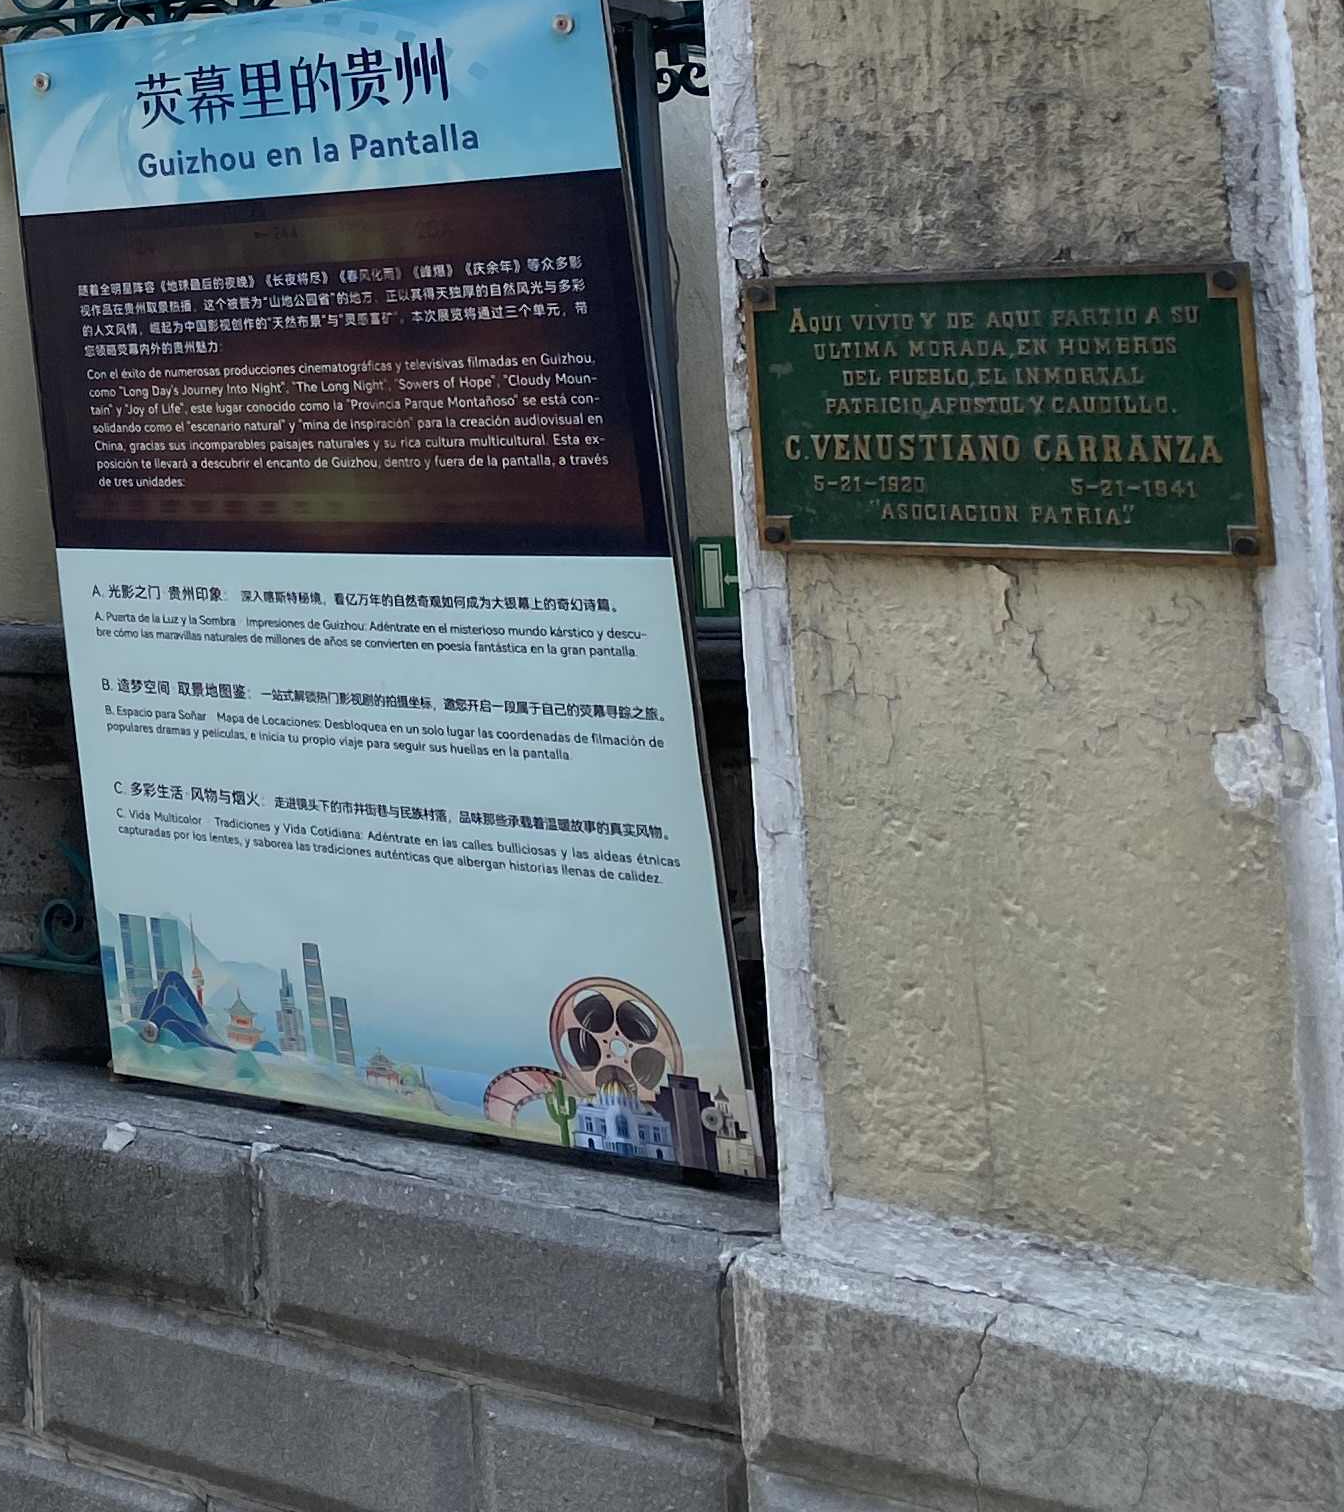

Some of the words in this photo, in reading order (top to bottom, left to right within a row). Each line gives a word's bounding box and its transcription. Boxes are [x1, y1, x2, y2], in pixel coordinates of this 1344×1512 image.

[134, 37, 449, 130] 荧幕里的贵州
[137, 147, 256, 178] Guizhou
[266, 146, 303, 168] en
[312, 136, 340, 164] la
[349, 122, 479, 161] Pantalla
[789, 307, 842, 335] AQUI
[851, 313, 914, 332] VIVIO
[919, 311, 937, 330] Y
[946, 311, 975, 330] DE
[986, 309, 1042, 330] AQUI
[1052, 308, 1137, 328] PARTIO
[1145, 306, 1161, 325] A
[1171, 306, 1199, 325] SU
[814, 340, 897, 361] ULTIMA
[1016, 338, 1047, 356] EN
[1059, 336, 1178, 355] HOMBROS
[86, 368, 107, 380] Con
[109, 368, 119, 380] el
[120, 368, 146, 379] éxito
[148, 367, 162, 379] de
[164, 367, 221, 378] numerosas
[223, 364, 296, 379] producciones
[298, 359, 393, 376] cinematográficas
[404, 358, 465, 371] televisivas
[466, 354, 519, 368] filmadas
[521, 356, 538, 366] en
[842, 369, 881, 387] DEL
[976, 367, 1008, 386] EL
[1015, 366, 1146, 386] INMORTAL
[88, 388, 117, 398] como
[181, 384, 224, 398] Journey
[226, 383, 248, 395] Into
[320, 381, 350, 395] Long
[442, 376, 456, 389] of
[554, 372, 598, 385] Moun-
[147, 402, 159, 415] of
[190, 403, 213, 414] este
[215, 402, 243, 416] lugar
[246, 400, 296, 413] conocido
[298, 401, 330, 412] como
[332, 400, 344, 411] la
[404, 397, 444, 411] Parque
[522, 396, 537, 407] se
[540, 393, 568, 406] está
[570, 395, 600, 405] con-
[930, 396, 1025, 415] APOSTOL
[1028, 395, 1045, 415] Y
[1052, 395, 1178, 415] CAUDILLO.
[92, 421, 142, 434] solidando
[143, 423, 173, 433] como
[174, 421, 185, 433] el
[332, 418, 348, 430] de
[417, 419, 443, 431] para
[445, 416, 457, 428] la
[459, 415, 511, 428] creación
[513, 412, 584, 427] audiovisual
[587, 414, 604, 425] en
[94, 439, 127, 452] China,
[128, 441, 166, 454] gracias
[168, 442, 187, 451] sus
[189, 438, 267, 453] incomparables
[269, 440, 314, 453] paisajes
[317, 438, 370, 450] naturales
[383, 439, 397, 449] su
[400, 437, 422, 448] rica
[425, 436, 466, 448] cultura
[552, 433, 580, 446] Esta
[584, 435, 605, 445] ex-
[1033, 434, 1224, 464] CARRANZA
[96, 458, 139, 472] posición
[140, 459, 152, 469] te
[154, 457, 188, 469] llevará
[200, 457, 250, 469] descubrir
[253, 457, 264, 469] el
[265, 458, 311, 469] encanto
[313, 457, 329, 469] de
[383, 456, 421, 468] dentro
[434, 454, 465, 468] fuera
[468, 454, 484, 467] de
[486, 454, 499, 467] la
[501, 453, 556, 470] pantalla,
[569, 452, 609, 466] través
[98, 476, 112, 487] de
[113, 477, 134, 488] tres
[814, 475, 927, 493] 5-21-1920
[1070, 477, 1197, 498] 5-21-1941
[118, 825, 171, 839] capturadas
[173, 830, 190, 841] por
[192, 830, 208, 842] los
[252, 837, 294, 851] saborea
[295, 840, 311, 852] las
[312, 843, 372, 858] tradiciones
[374, 849, 431, 864] auténticas
[432, 855, 454, 867] que
[456, 855, 507, 872] albergan
[508, 859, 559, 875] historias
[561, 863, 596, 879] llenas
[598, 867, 615, 880] de
